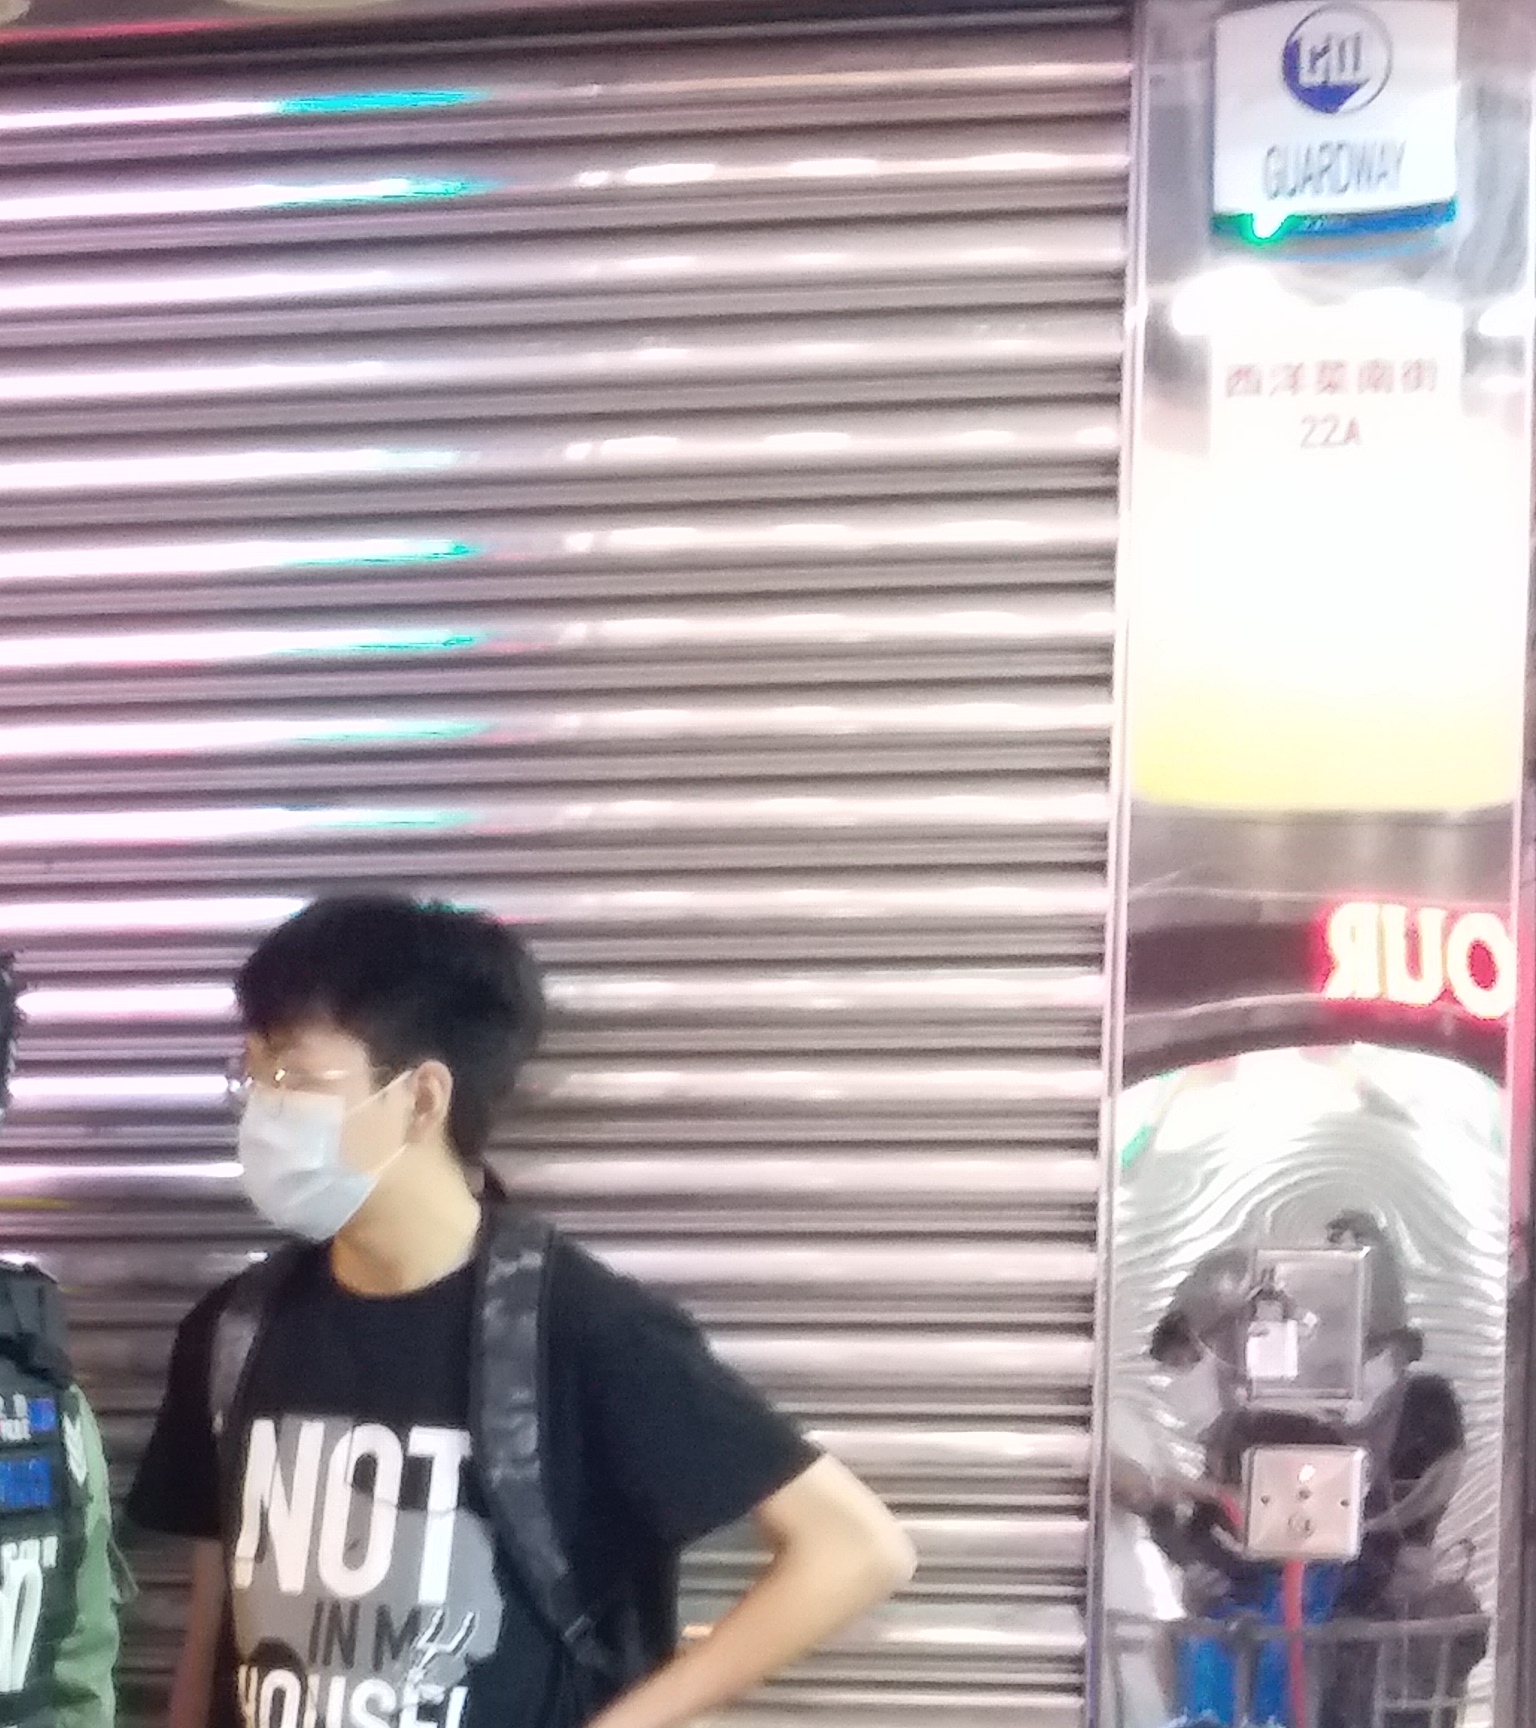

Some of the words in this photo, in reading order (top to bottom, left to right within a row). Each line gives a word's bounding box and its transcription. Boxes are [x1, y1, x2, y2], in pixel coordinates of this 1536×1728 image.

[1299, 414, 1363, 449] 22A
[234, 1418, 473, 1608] NOT
[308, 1599, 361, 1670] IN
